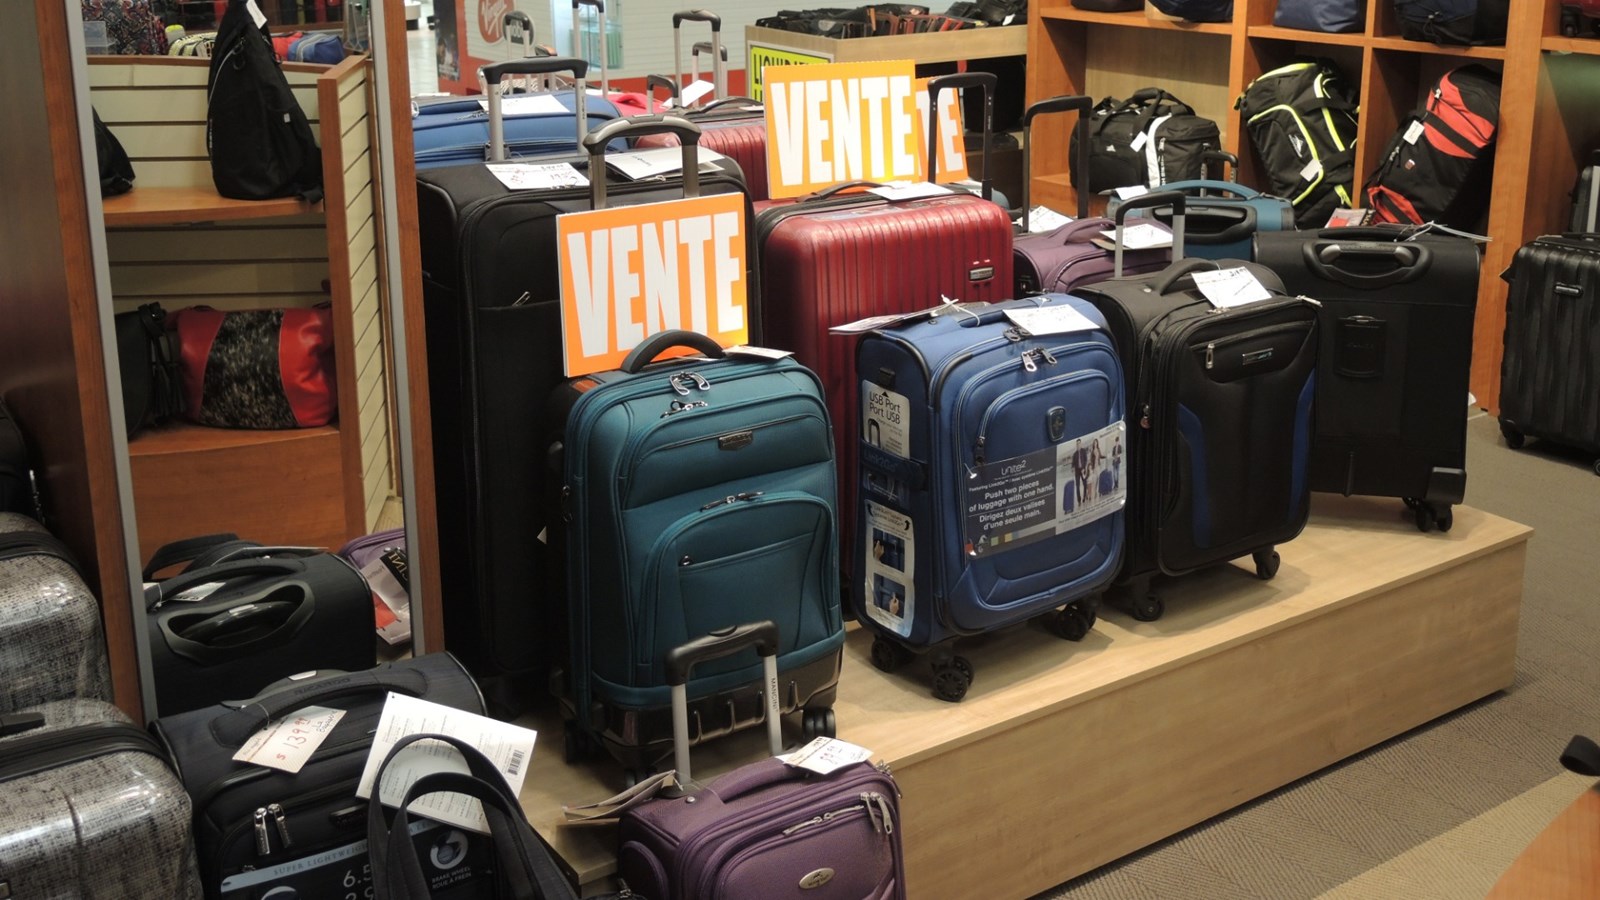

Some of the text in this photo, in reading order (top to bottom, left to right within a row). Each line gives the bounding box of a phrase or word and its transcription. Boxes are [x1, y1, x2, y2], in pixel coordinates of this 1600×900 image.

[770, 75, 915, 186] VENTE
[567, 211, 743, 358] VENTE
[869, 391, 901, 414] USB Port
[869, 402, 901, 425] Port USB
[968, 483, 1054, 513] of luggage with one hand.
[985, 480, 1039, 500] Push two pieces
[979, 511, 1004, 523] Dirigez
[1005, 506, 1022, 516] deux
[1023, 499, 1046, 511] valises
[983, 509, 1042, 530] d'une seule main.
[273, 844, 368, 876] SUPER LIGHTWEIGH
[431, 867, 471, 883] BRAKE WHEEL
[432, 880, 449, 889] ROUE
[455, 871, 472, 881] FREIN
